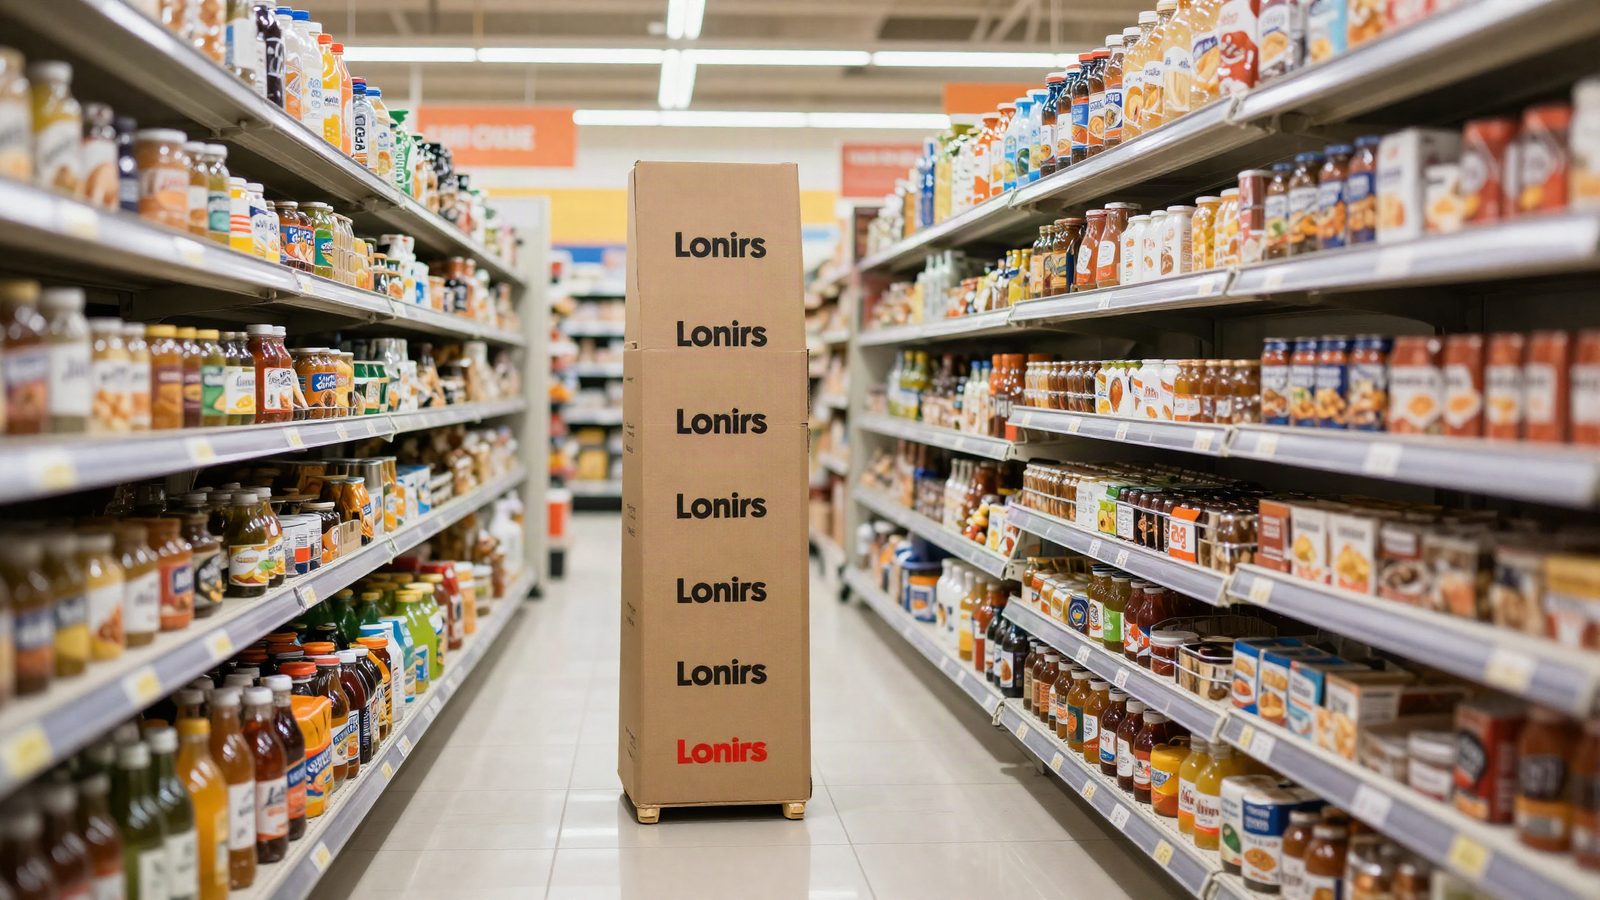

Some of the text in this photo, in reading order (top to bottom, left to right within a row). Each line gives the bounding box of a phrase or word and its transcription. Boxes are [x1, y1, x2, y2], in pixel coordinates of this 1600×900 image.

[675, 231, 766, 258] Lonirs
[676, 320, 767, 347] Lonirs
[676, 408, 767, 434] Lonirs
[676, 492, 767, 519] Lonirs
[677, 576, 767, 603] Lonirs
[677, 659, 767, 686] Lonirs
[677, 737, 768, 764] Lonirs
